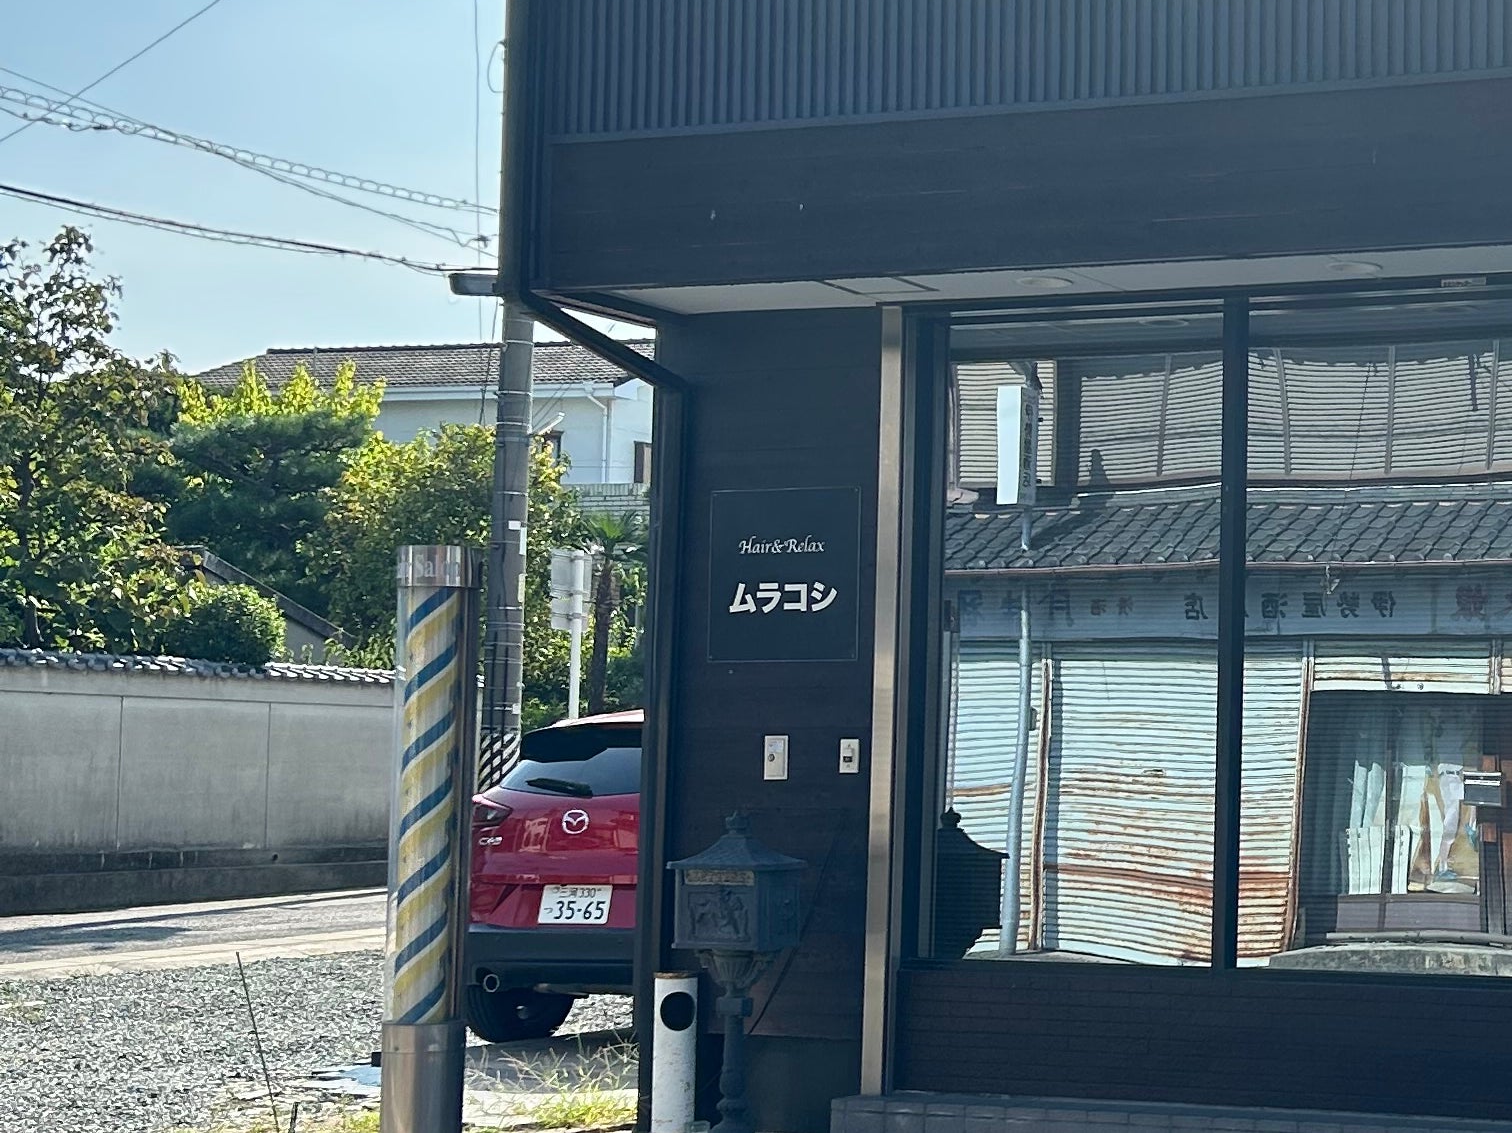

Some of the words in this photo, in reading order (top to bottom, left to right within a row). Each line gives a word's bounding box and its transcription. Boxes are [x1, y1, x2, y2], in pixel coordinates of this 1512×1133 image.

[728, 581, 838, 614] ムラコシ
[579, 888, 596, 898] 330
[554, 901, 605, 919] 35-65
